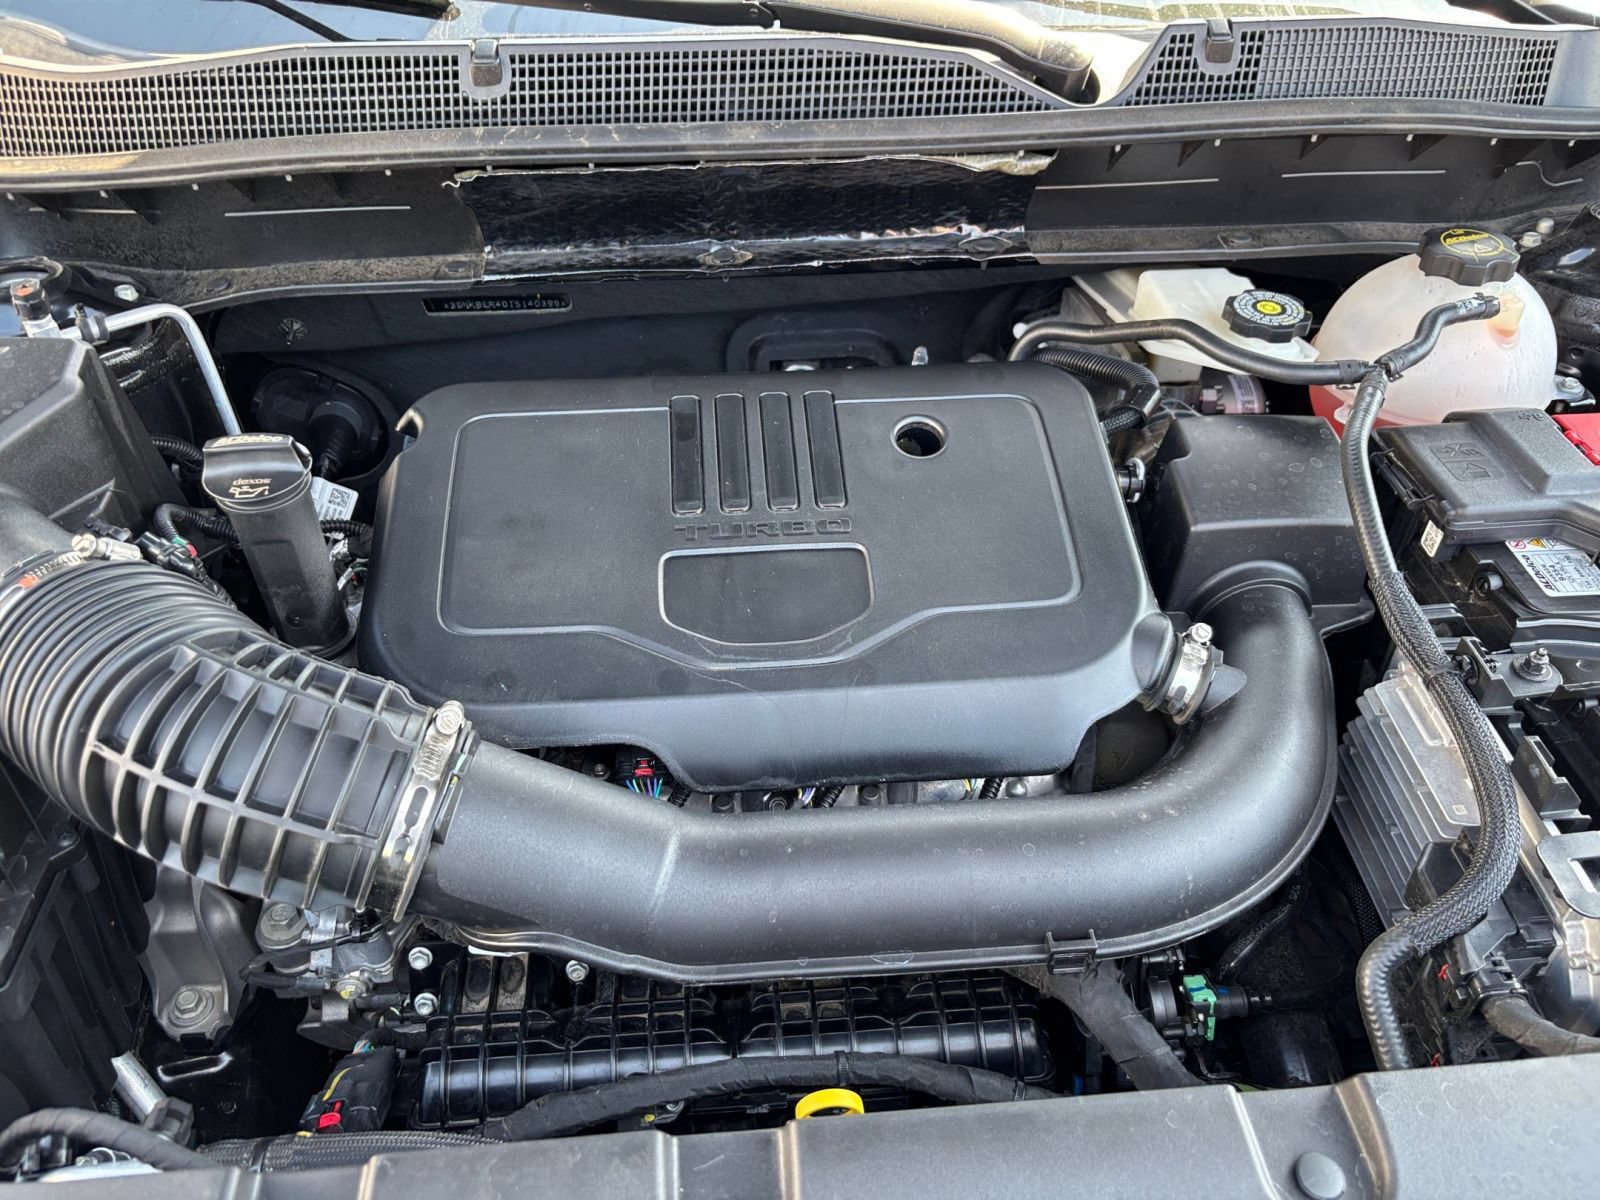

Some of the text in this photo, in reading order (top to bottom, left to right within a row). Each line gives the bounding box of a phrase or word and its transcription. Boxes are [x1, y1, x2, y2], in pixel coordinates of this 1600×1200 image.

[211, 434, 284, 448] ACDelco
[232, 478, 273, 486] dexos
[673, 517, 852, 541] TURBO
[1521, 554, 1556, 591] ACDelco
